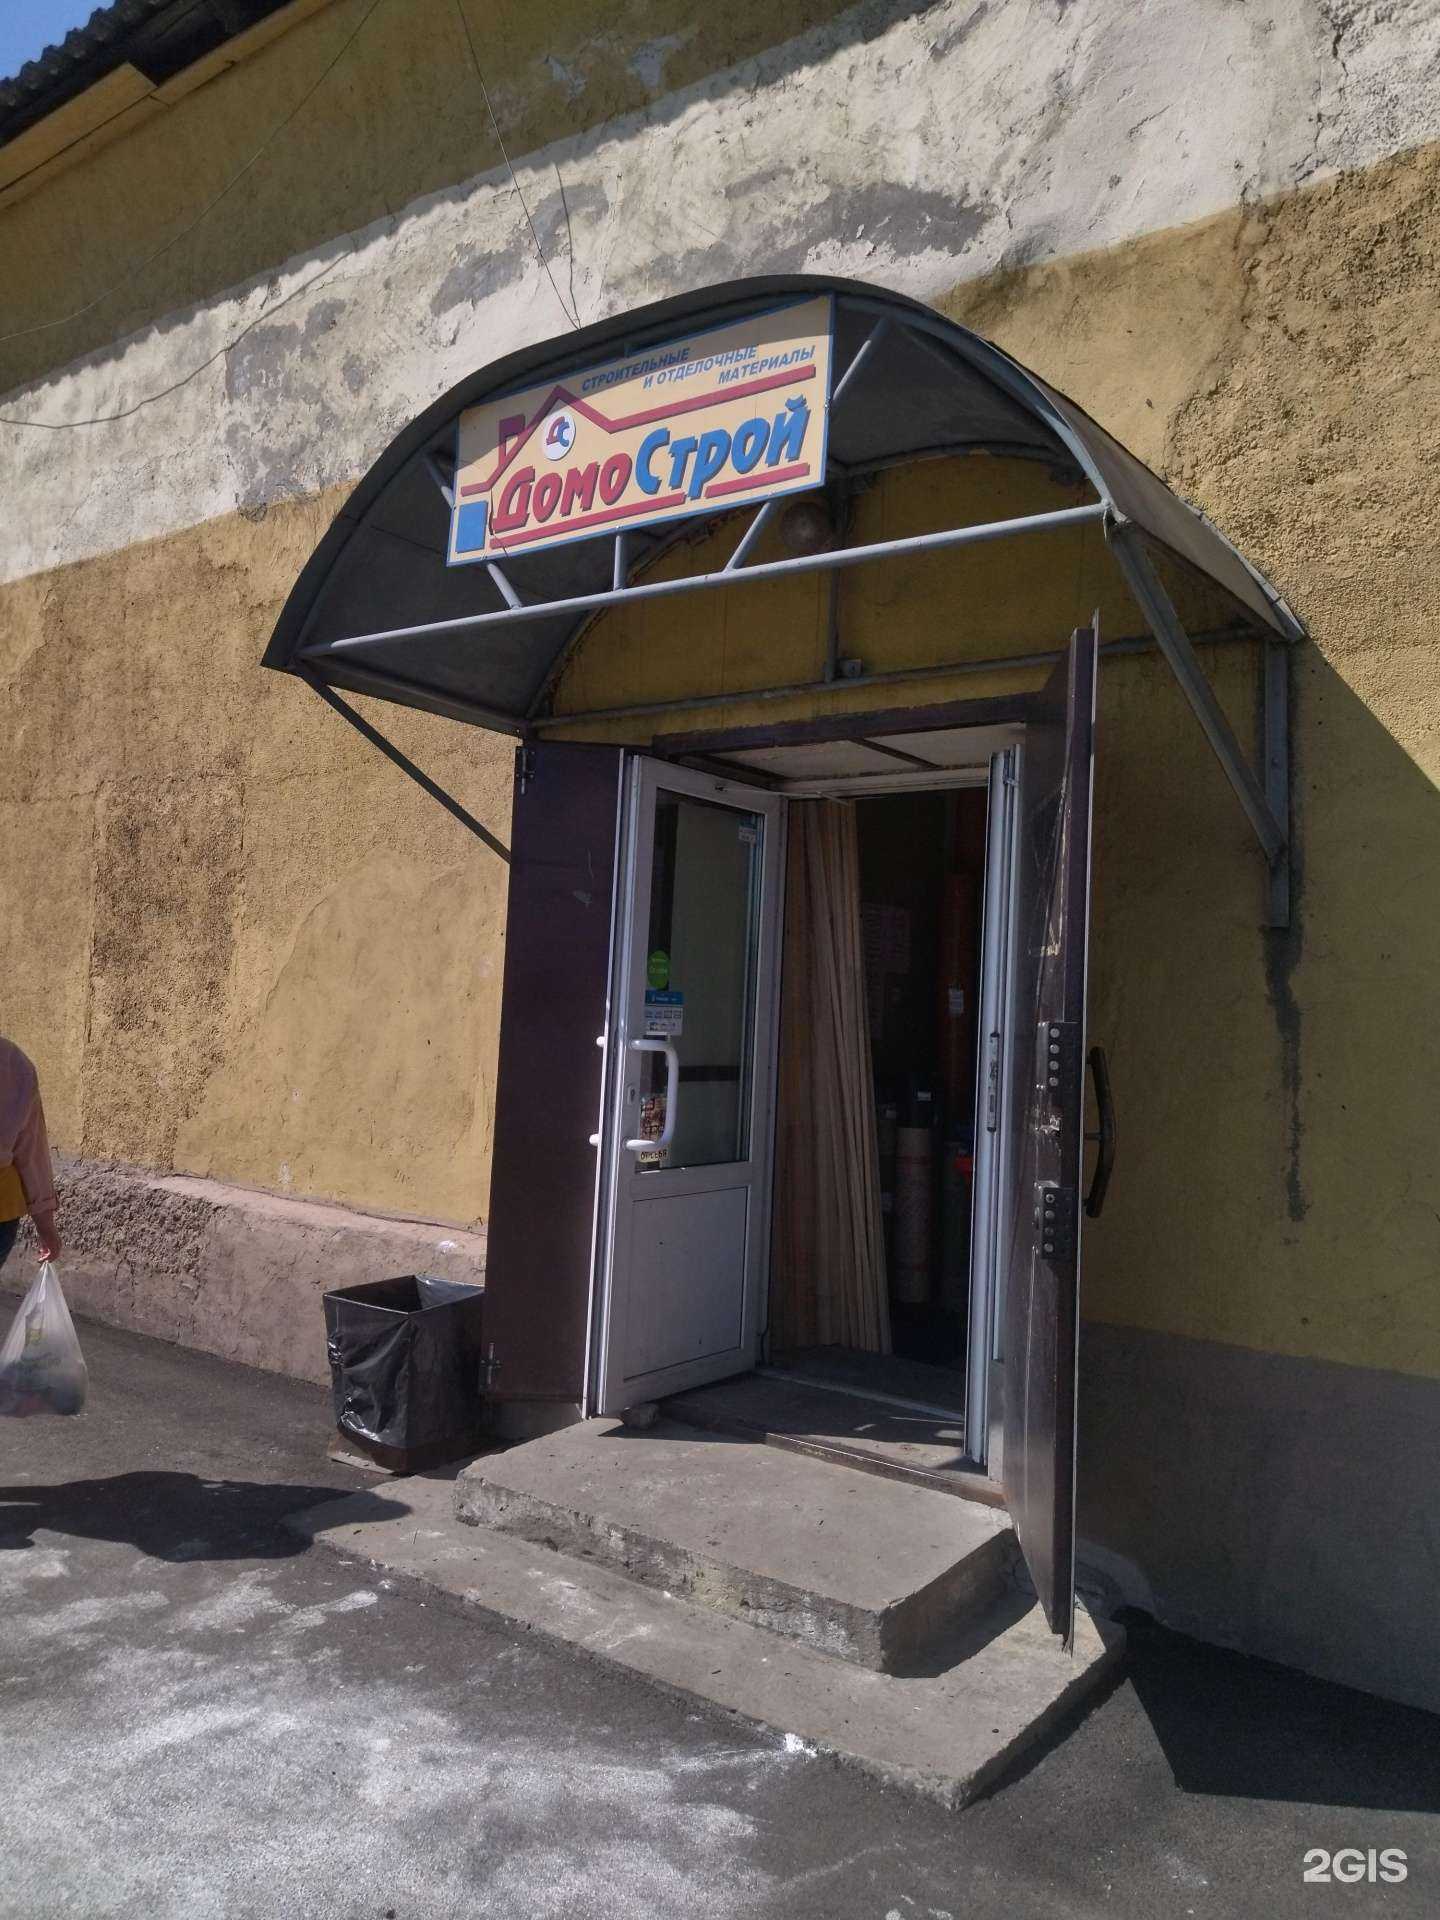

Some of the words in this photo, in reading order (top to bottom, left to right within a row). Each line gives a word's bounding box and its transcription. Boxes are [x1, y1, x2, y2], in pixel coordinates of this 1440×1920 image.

[582, 347, 690, 392] СТРОИТЕЛЬНЫЕ
[642, 372, 653, 390] И
[657, 343, 758, 386] ОТДЕЛОЧНЫЕ
[718, 345, 816, 385] МАТЕРИАЛЫ
